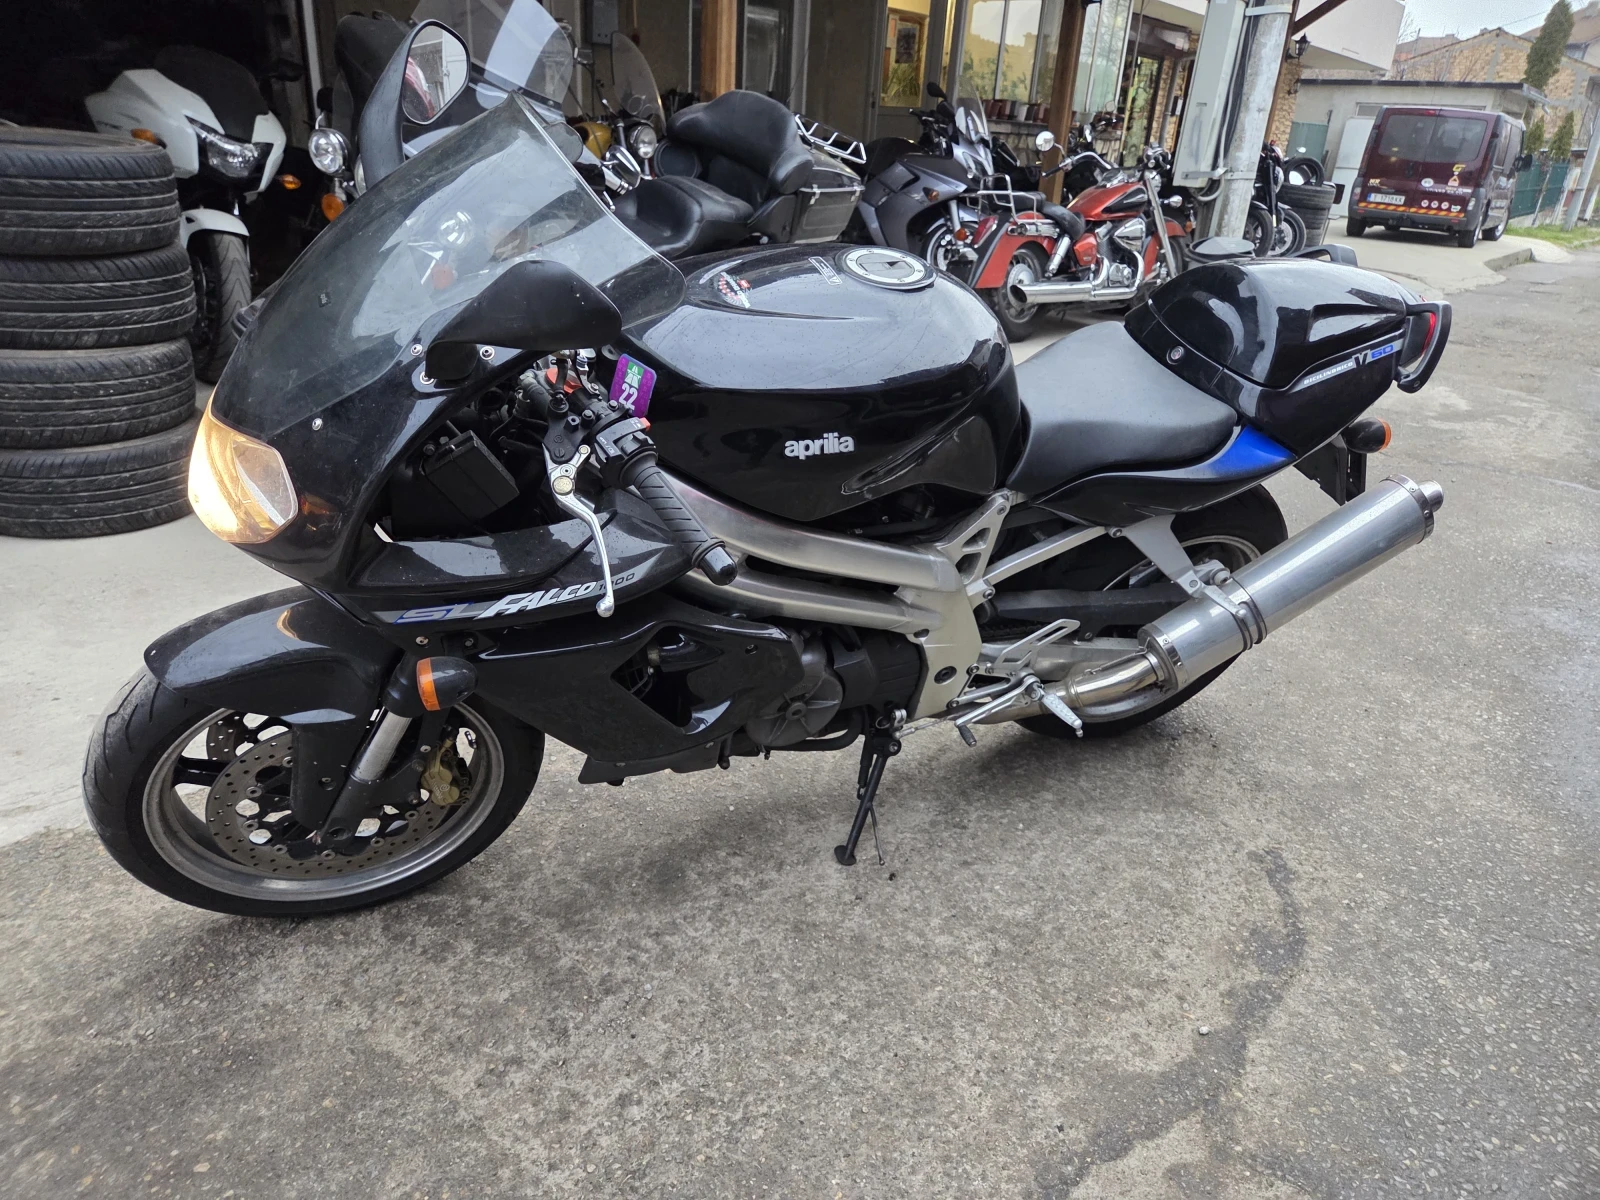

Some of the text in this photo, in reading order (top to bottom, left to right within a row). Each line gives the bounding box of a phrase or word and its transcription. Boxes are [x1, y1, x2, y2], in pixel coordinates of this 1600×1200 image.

[618, 382, 638, 411] 22
[784, 432, 855, 460] aprilia
[393, 573, 635, 624] SL FALCO 100
